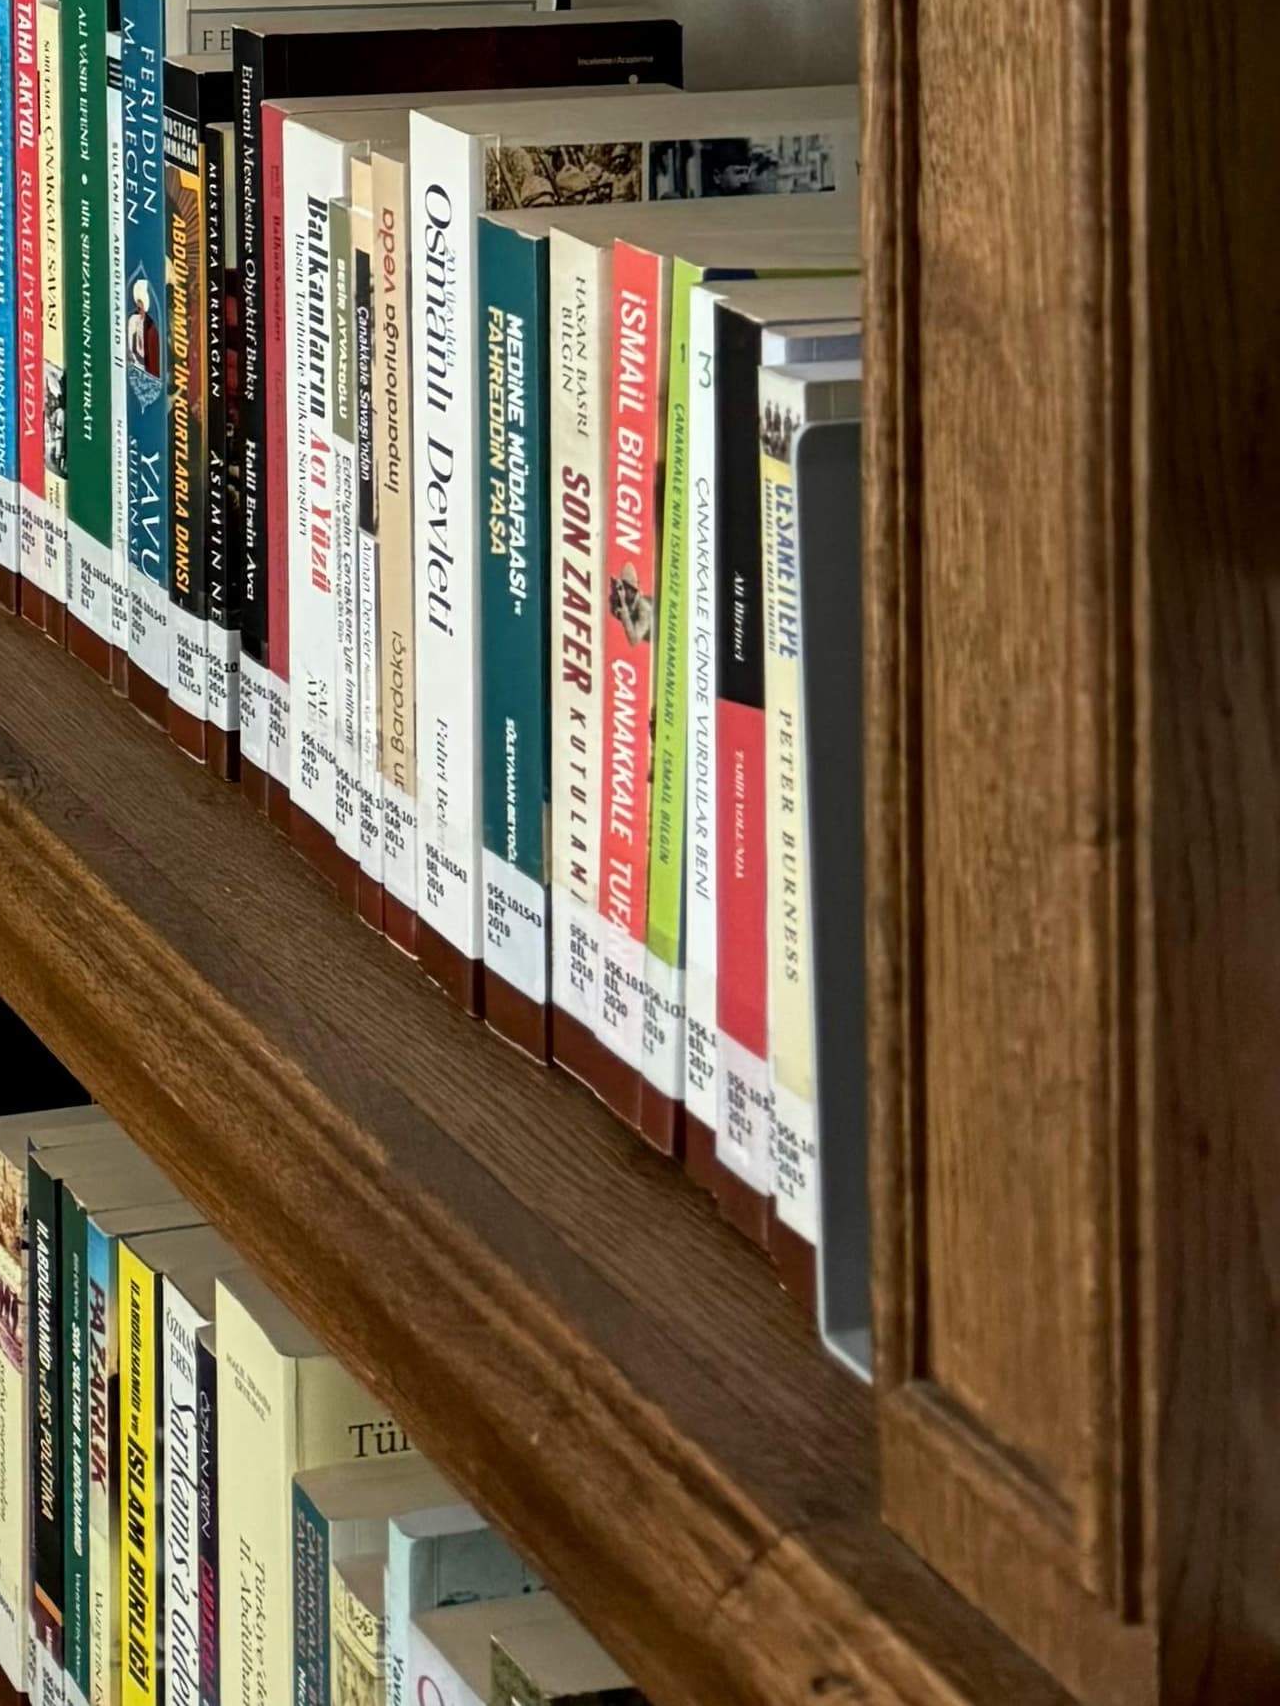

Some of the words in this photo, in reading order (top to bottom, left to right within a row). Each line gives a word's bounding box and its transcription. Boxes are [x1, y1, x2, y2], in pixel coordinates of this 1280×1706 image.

[17, 1, 33, 62] TAHA
[120, 15, 136, 56] M.
[17, 64, 35, 152] AKYOL
[123, 73, 139, 226] EMECEN
[140, 43, 158, 216] FERİDUN
[20, 167, 35, 323] RUMELİ'YE
[208, 161, 219, 269] MUSTAFA
[382, 207, 397, 295] veda
[172, 211, 192, 390] ABDÜLHAMİD'İN
[209, 279, 221, 399] ARMAĞAN
[307, 192, 330, 420] Balkanların
[357, 304, 371, 386] Çanakkale
[424, 182, 453, 414] Osmanlı
[561, 305, 575, 393] BİLGİN
[574, 274, 588, 351] HASAN
[620, 289, 647, 416] İSMAİL
[21, 329, 37, 440] ELVEDA
[383, 303, 401, 496] İmparatorluğa
[487, 305, 506, 470] FAHREDDİN
[505, 312, 525, 425] MEDİNE
[574, 356, 589, 439] BASRİ
[173, 393, 191, 516] KURTLARLA
[309, 426, 332, 495] Acı
[358, 387, 372, 483] Savaşı'ndan
[615, 421, 647, 556] BİLGİN
[173, 520, 191, 594] DANSI
[310, 500, 333, 595] Yüzü
[427, 433, 454, 639] Devleti
[489, 477, 507, 556] PAŞA
[506, 431, 528, 604] MÜDAFAASI
[561, 465, 593, 551] SON
[694, 476, 711, 617] ÇANAKKALE
[561, 558, 593, 695] ZAFER
[694, 618, 711, 705] İÇİNDE
[388, 630, 407, 757] Bardakçı
[695, 714, 711, 837] VURDULAR
[778, 708, 794, 814] PETER
[694, 842, 711, 901] BENİ
[779, 830, 800, 986] BURNESS
[198, 1389, 212, 1469] ÖZHAN
[200, 1472, 212, 1540] EREN
